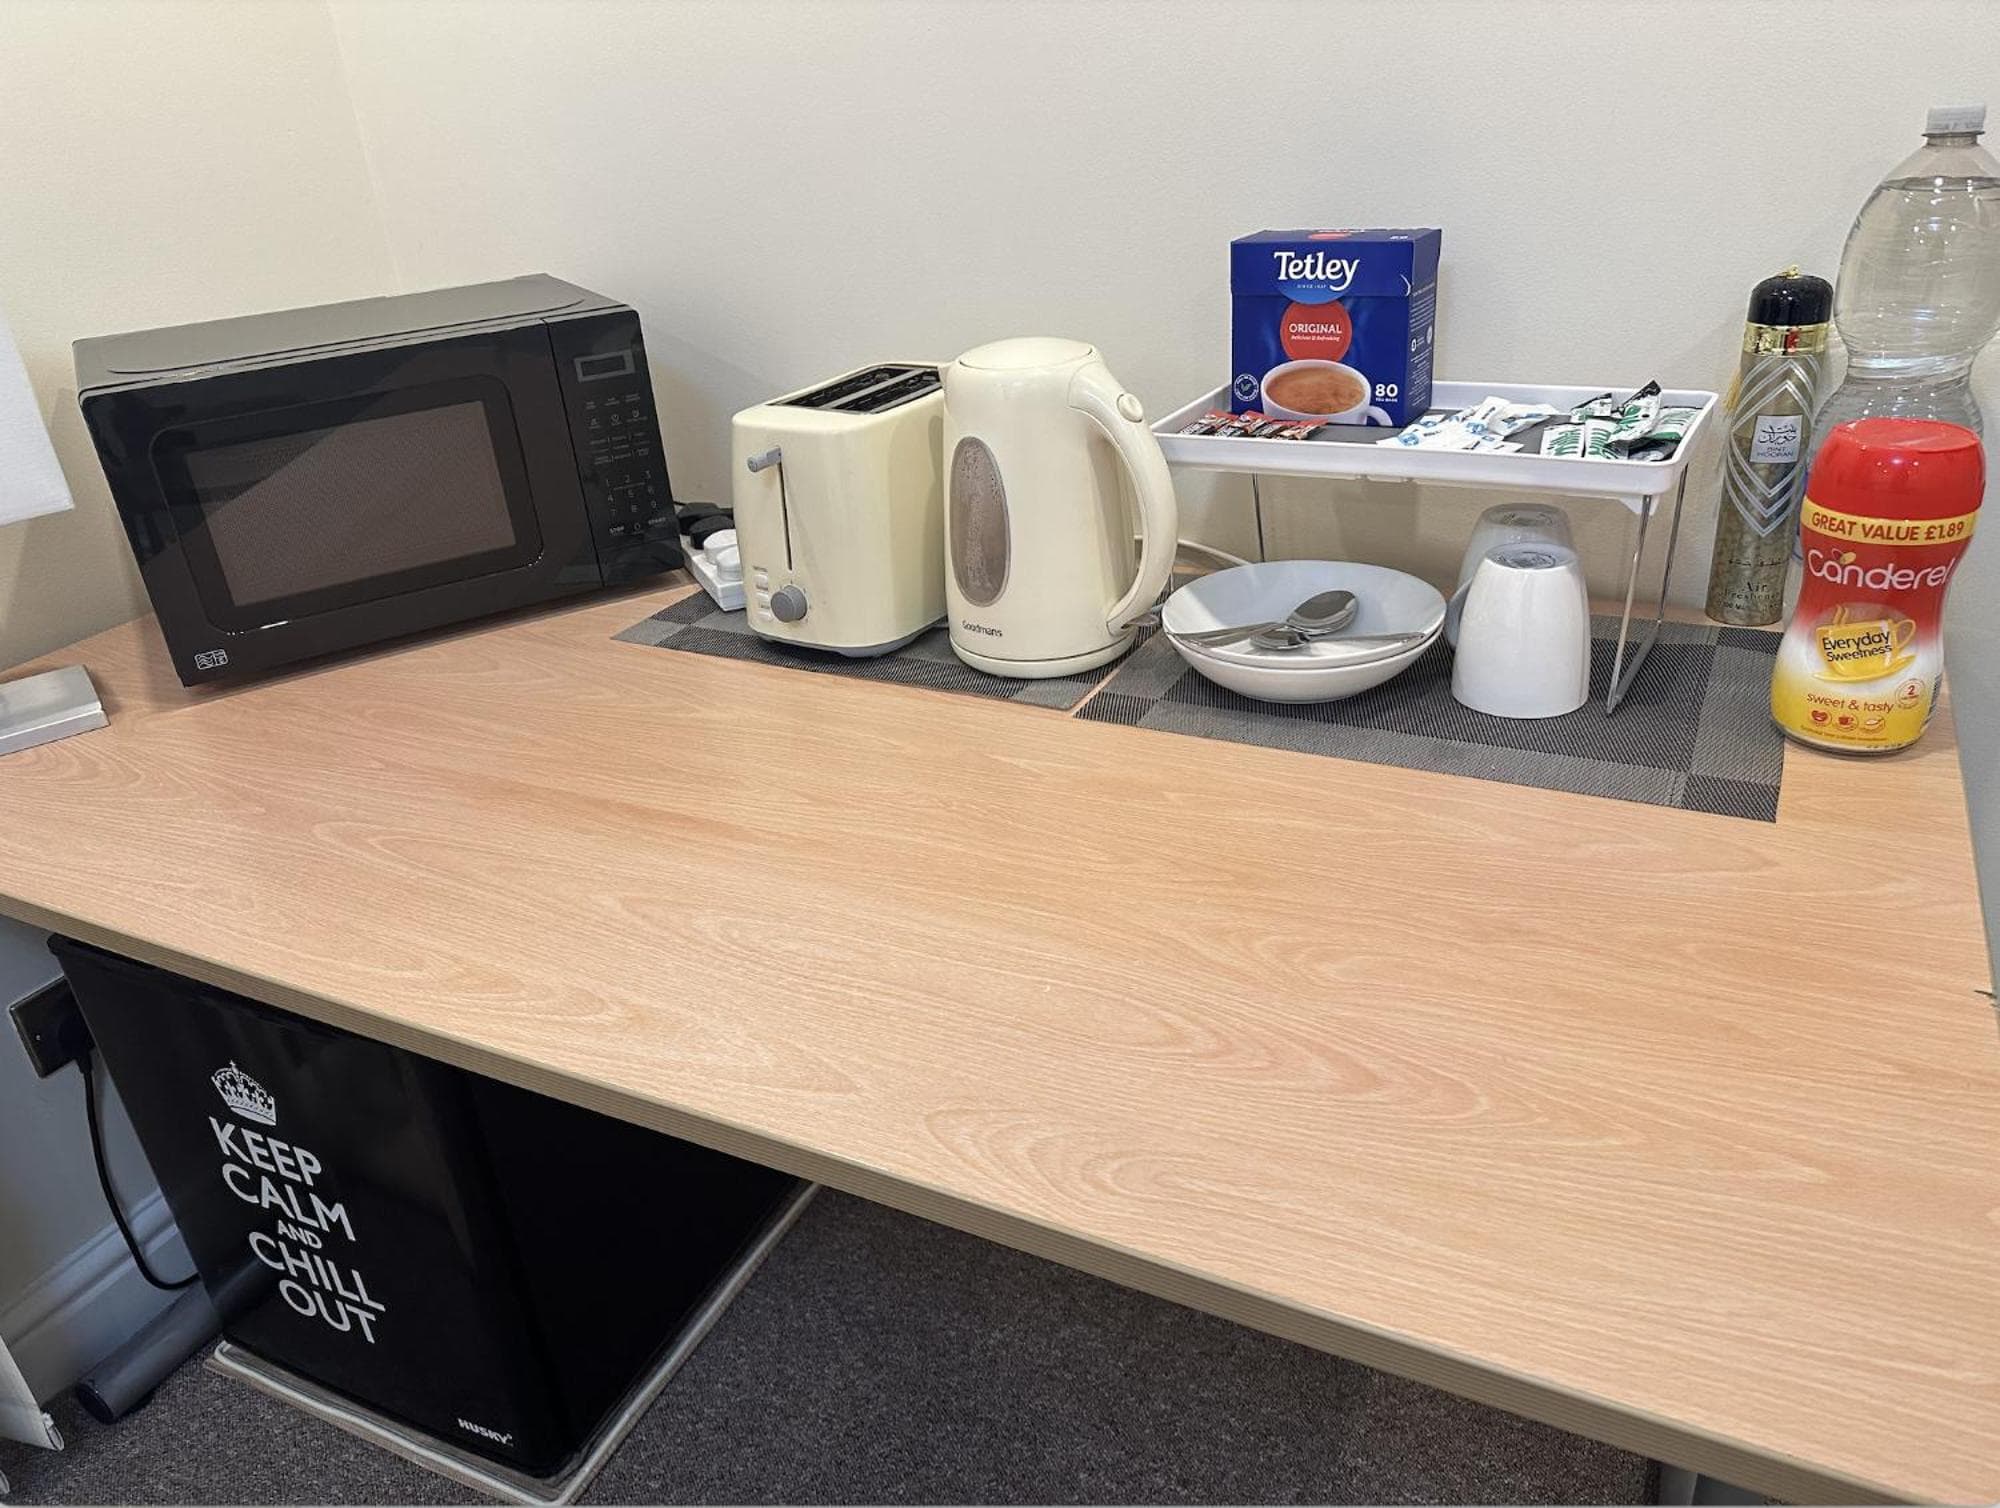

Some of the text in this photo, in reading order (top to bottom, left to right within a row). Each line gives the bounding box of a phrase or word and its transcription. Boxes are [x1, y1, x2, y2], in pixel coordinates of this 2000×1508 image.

[1273, 251, 1360, 291] Tetley
[1289, 323, 1343, 334] ORIGINAL
[1375, 383, 1398, 397] 80
[1811, 511, 1965, 541] GREAT VALUE £1.89
[1807, 549, 1956, 590] Canderel
[961, 619, 1003, 637] Goodmans
[1822, 631, 1890, 651] Everyday
[1826, 644, 1893, 662] Sweetness
[1806, 693, 1845, 708] sweet
[1848, 700, 1860, 711] &
[1863, 701, 1895, 714] tasty
[1907, 685, 1915, 696] 2
[208, 1115, 322, 1186] KEEP
[222, 1163, 356, 1242] CALM
[277, 1219, 323, 1250] AND
[248, 1231, 387, 1313] CHILL
[279, 1279, 377, 1344] OUT
[457, 1417, 508, 1445] HUSKY
